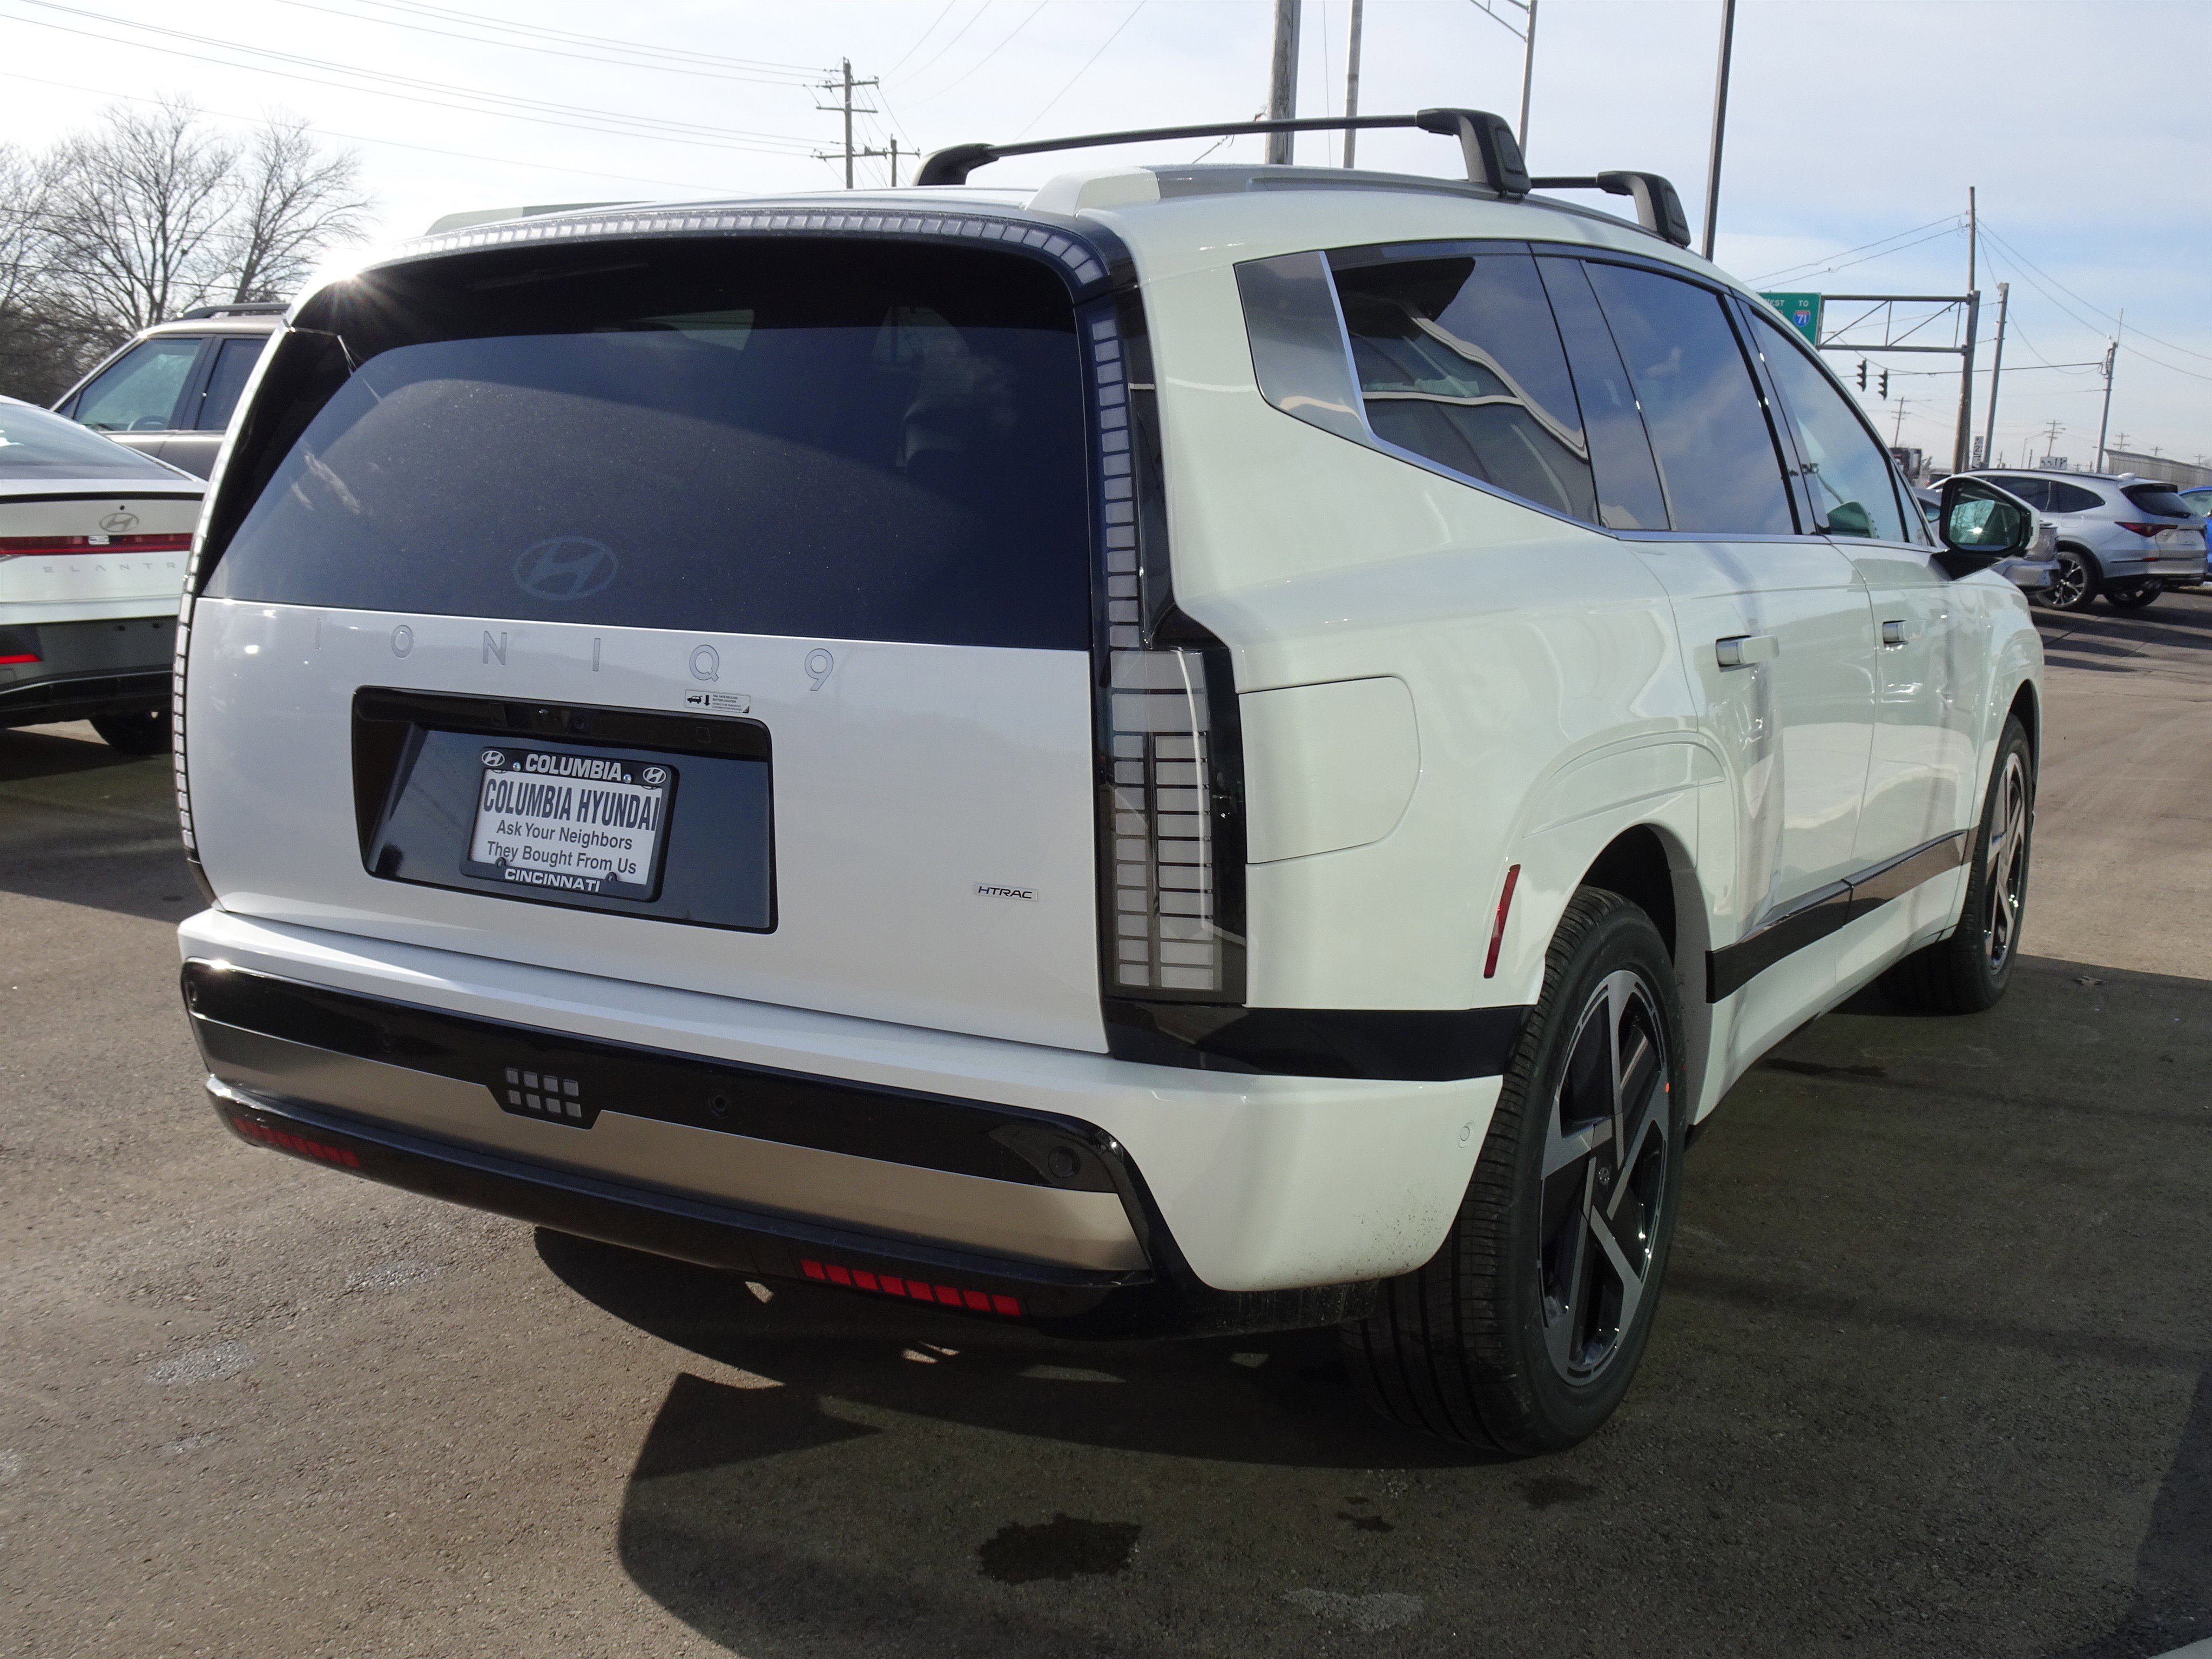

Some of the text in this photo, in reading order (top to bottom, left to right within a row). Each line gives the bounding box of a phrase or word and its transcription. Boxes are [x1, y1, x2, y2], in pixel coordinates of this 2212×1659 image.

[1797, 314, 1806, 323] 71
[43, 562, 176, 573] ELANTR
[314, 618, 834, 691] IONIQ 9
[525, 753, 622, 781] COLUMBIA
[483, 778, 660, 831] COLUMBIA HYUNDAI
[496, 820, 633, 849] Ask Your Neighbors
[487, 841, 637, 874] They Bought From Us
[504, 868, 601, 892] CINCINNATI
[978, 886, 1033, 899] HTRAC
